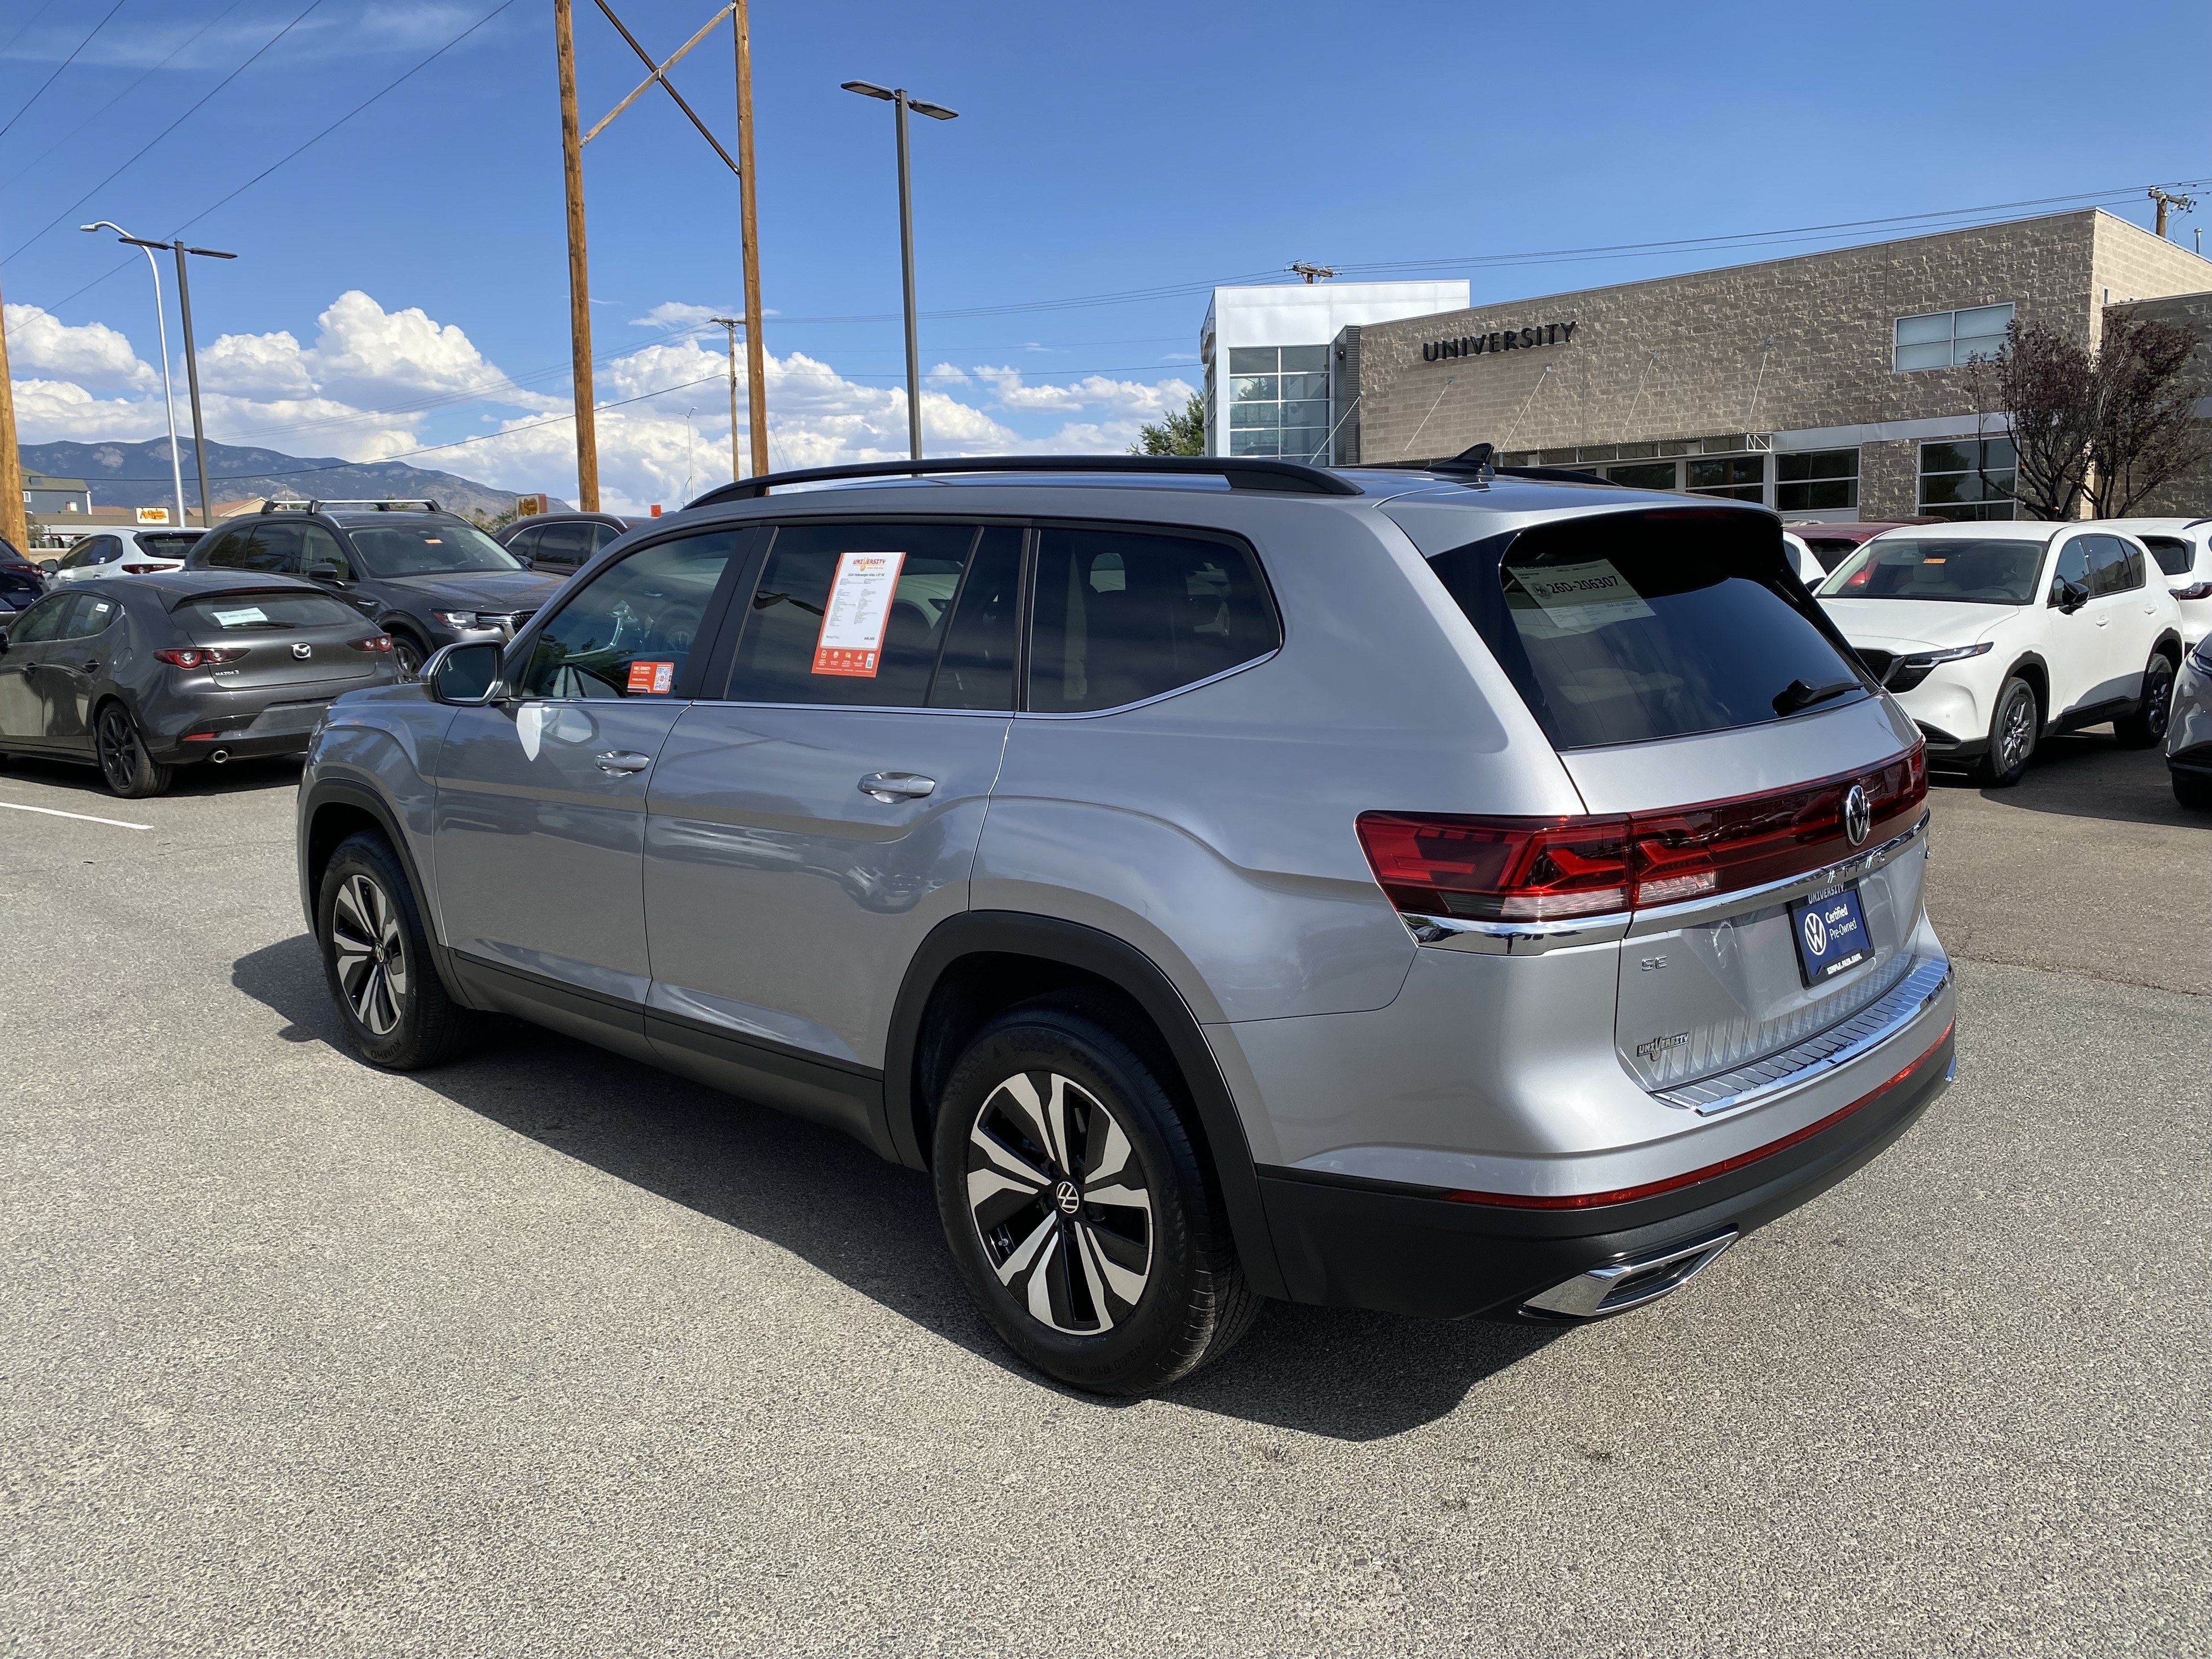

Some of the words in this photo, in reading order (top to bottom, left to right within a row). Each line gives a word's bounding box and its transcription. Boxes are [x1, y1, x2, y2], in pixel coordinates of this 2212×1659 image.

[1423, 321, 1578, 362] UNIVERSITY
[853, 557, 886, 566] UNIVERSITY
[1546, 575, 1619, 594] 26D-206307
[1808, 882, 1845, 904] UNIVERSITY
[1825, 903, 1849, 924] Certified
[1829, 917, 1858, 940] Pre-Owned
[1641, 955, 1667, 972] SE
[370, 1038, 402, 1059] KUMHO
[1638, 1032, 1689, 1057] UNIVERSITY
